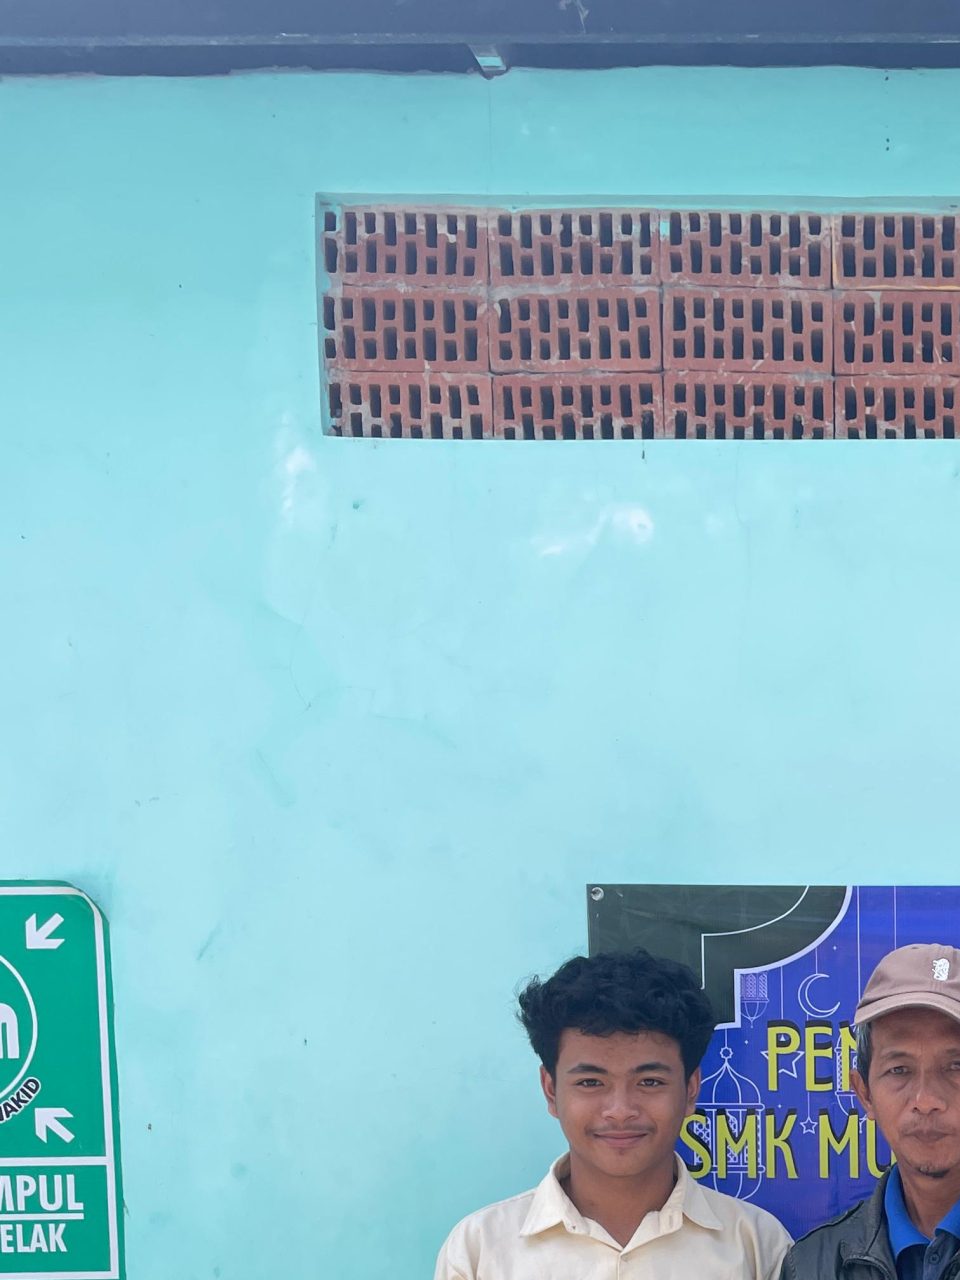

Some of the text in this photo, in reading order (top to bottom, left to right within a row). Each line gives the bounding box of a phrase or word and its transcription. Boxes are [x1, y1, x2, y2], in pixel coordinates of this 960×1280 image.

[0, 1078, 40, 1121] AKID
[679, 1113, 799, 1180] SMK
[0, 1222, 68, 1254] ELAK
